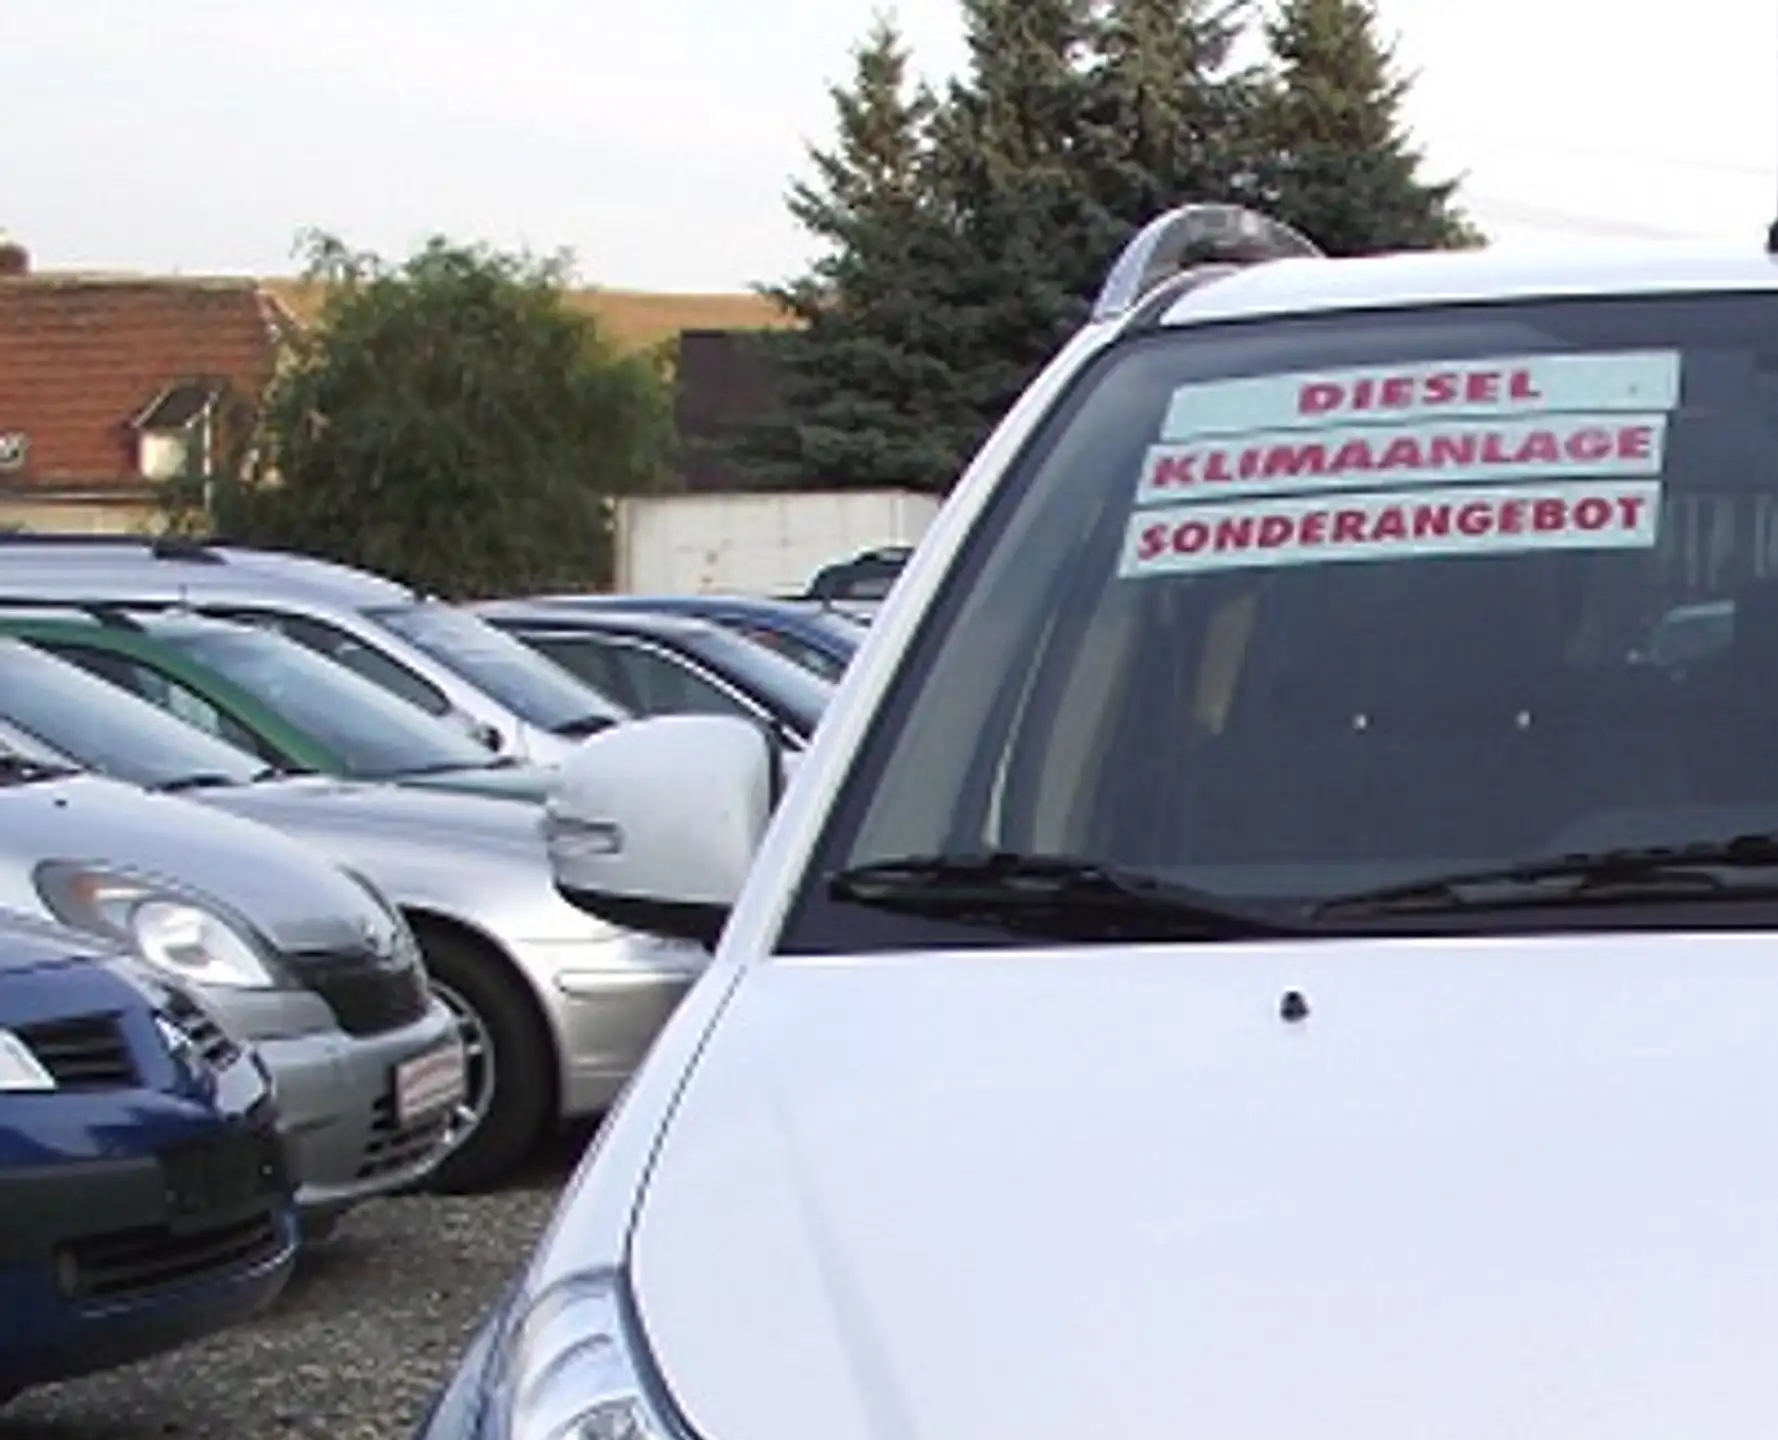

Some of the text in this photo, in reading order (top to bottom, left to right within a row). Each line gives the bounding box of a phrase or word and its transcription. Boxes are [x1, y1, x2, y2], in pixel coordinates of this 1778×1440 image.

[1298, 369, 1541, 414] DIESEL
[1150, 425, 1655, 488] KLIMAANLAGE
[1136, 496, 1647, 561] SONDERANGEBOT
